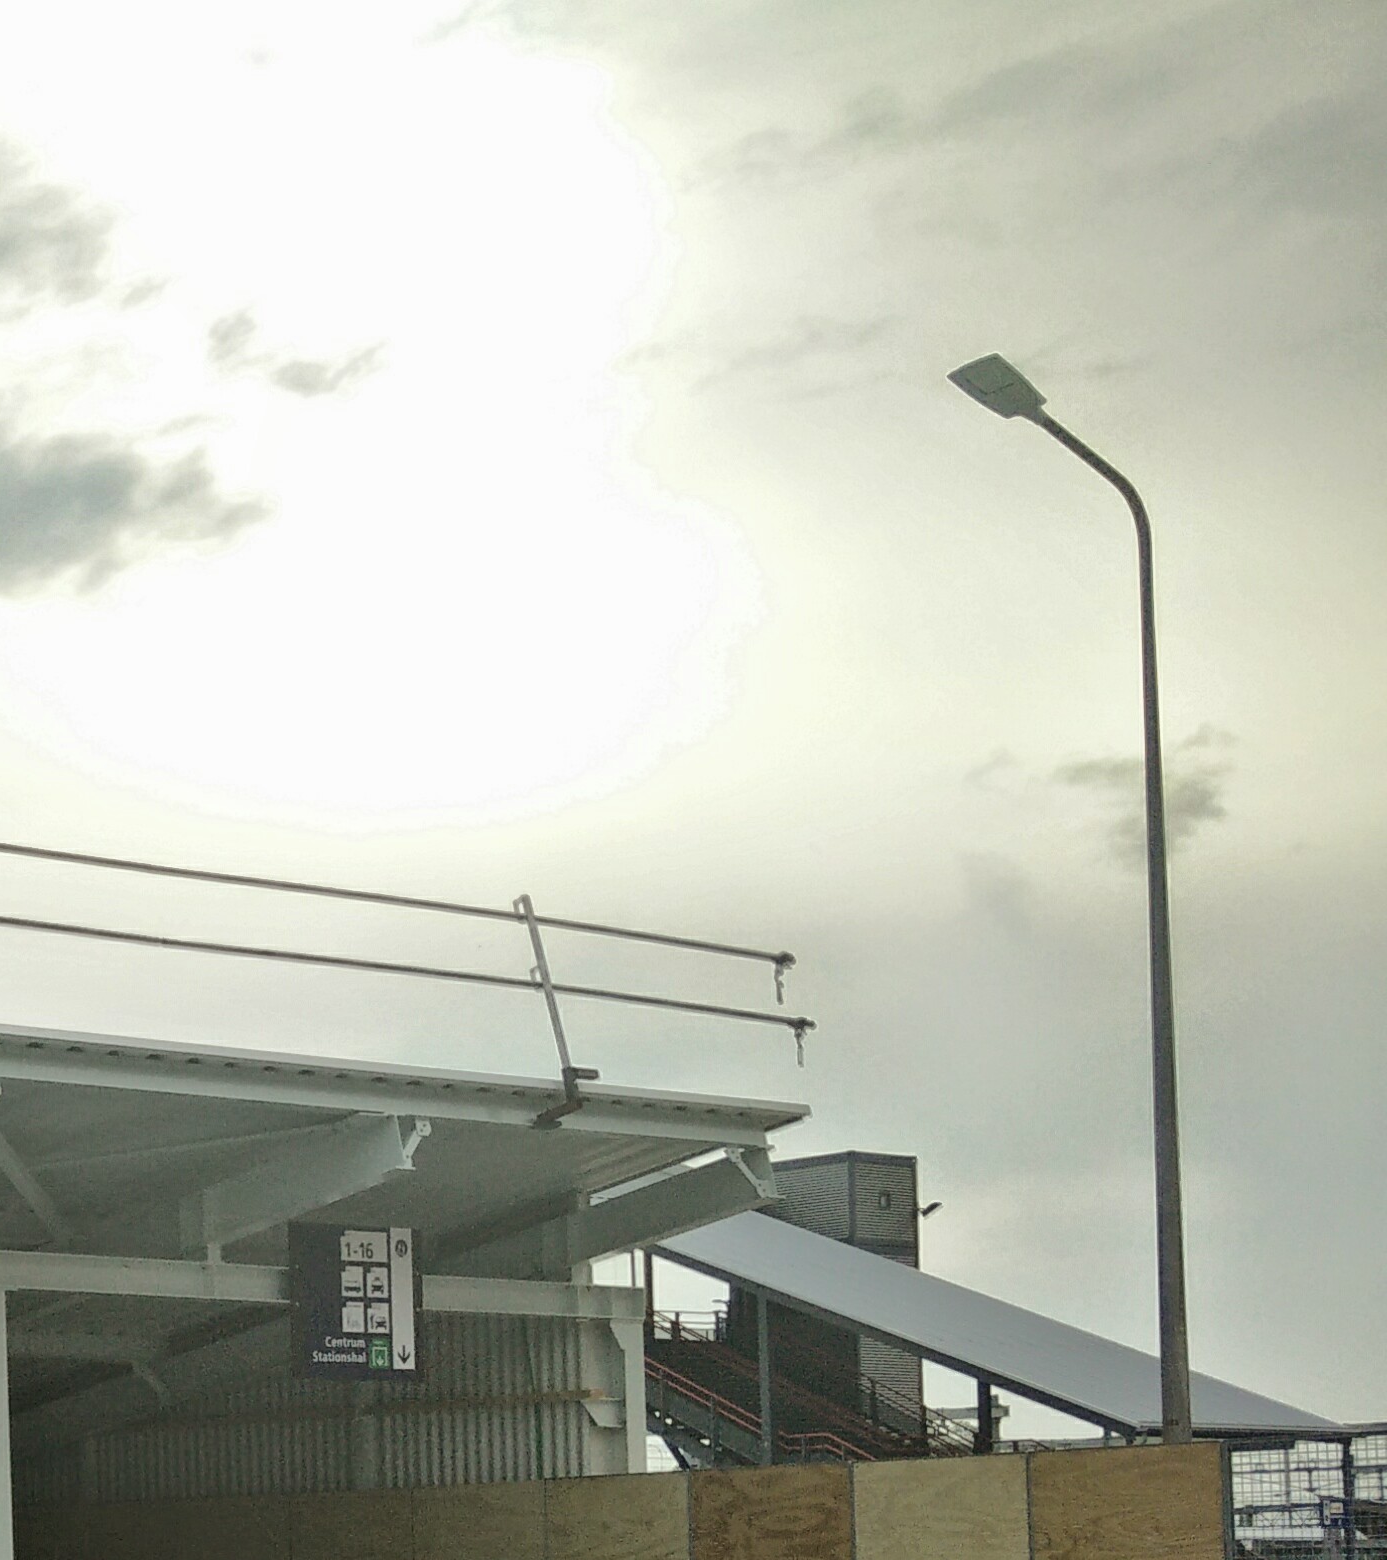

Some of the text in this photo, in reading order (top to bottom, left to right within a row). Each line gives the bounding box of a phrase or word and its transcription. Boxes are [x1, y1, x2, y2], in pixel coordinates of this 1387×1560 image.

[344, 1241, 374, 1260] 1-16
[324, 1336, 366, 1349] Centrum
[312, 1350, 367, 1363] Stationshal
